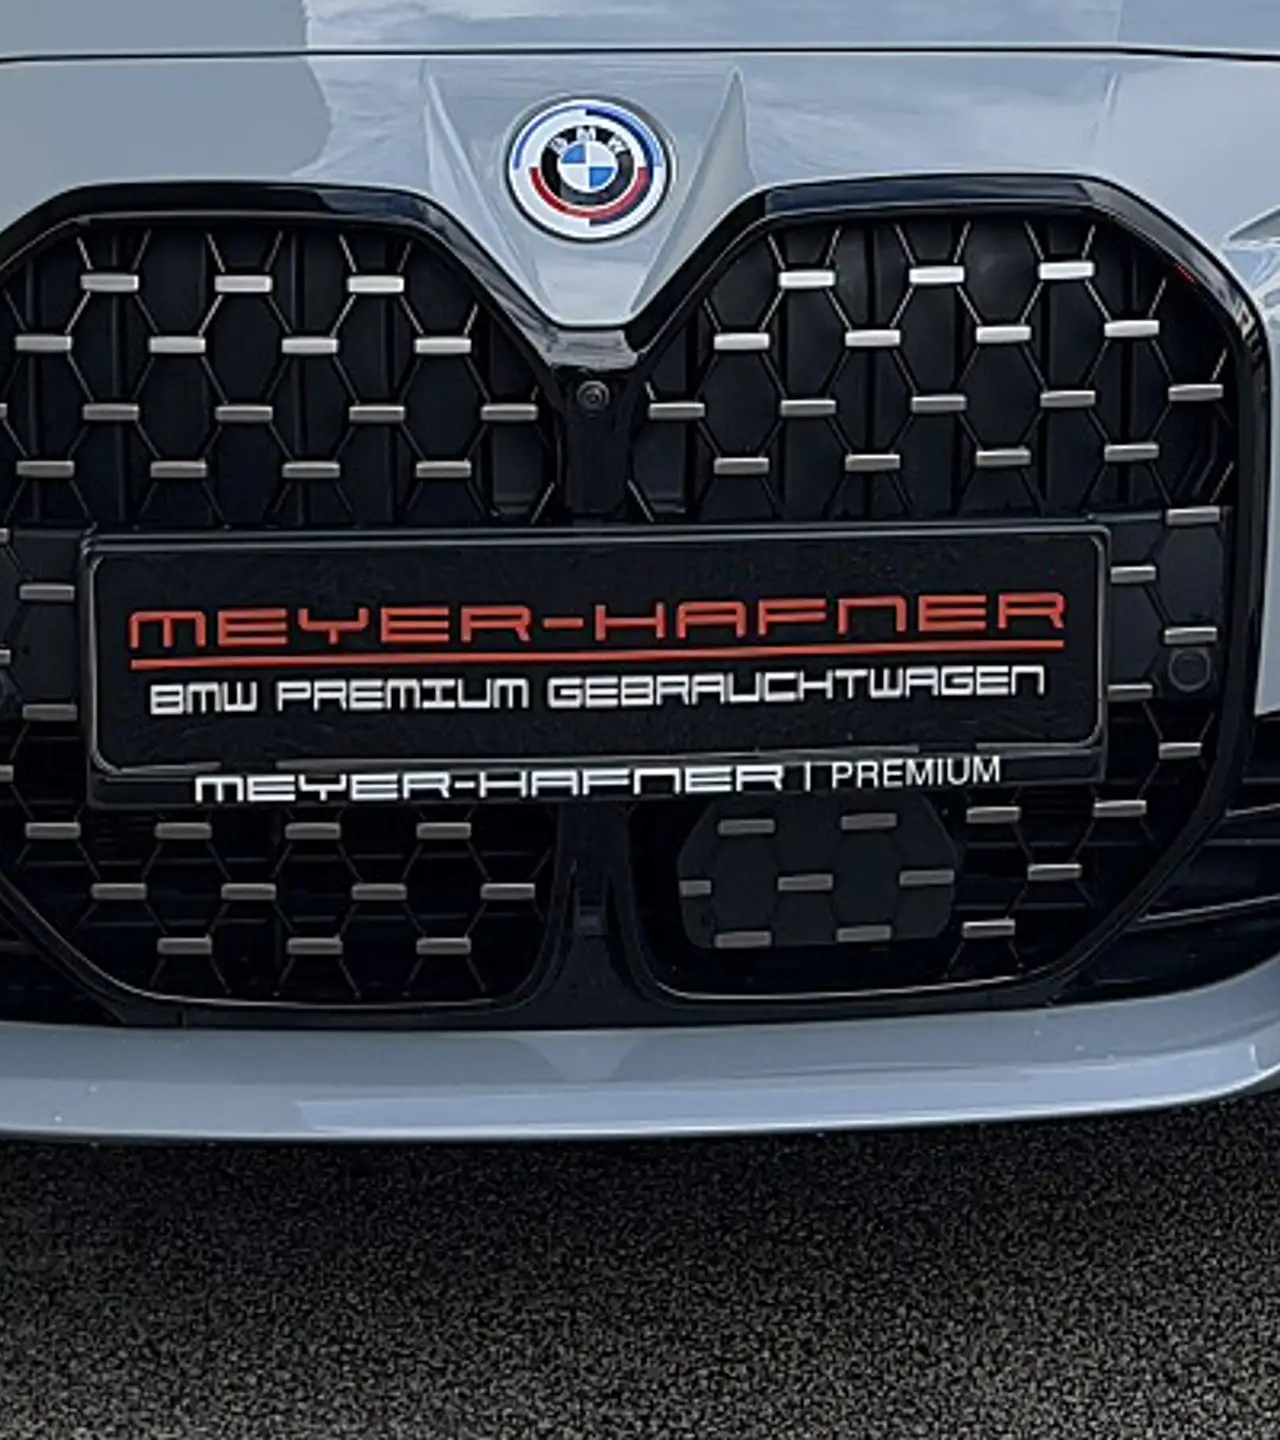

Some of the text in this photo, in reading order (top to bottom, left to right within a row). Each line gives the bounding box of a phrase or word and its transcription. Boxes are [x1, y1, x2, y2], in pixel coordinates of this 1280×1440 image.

[548, 126, 629, 155] BMW
[129, 594, 1066, 648] MEYER-HAFNER
[149, 665, 1046, 715] BMW PREMIUM GEBRAUCHTWAGEN
[194, 764, 785, 803] MEYER-HAFNER
[831, 754, 1002, 789] PREMIUM
